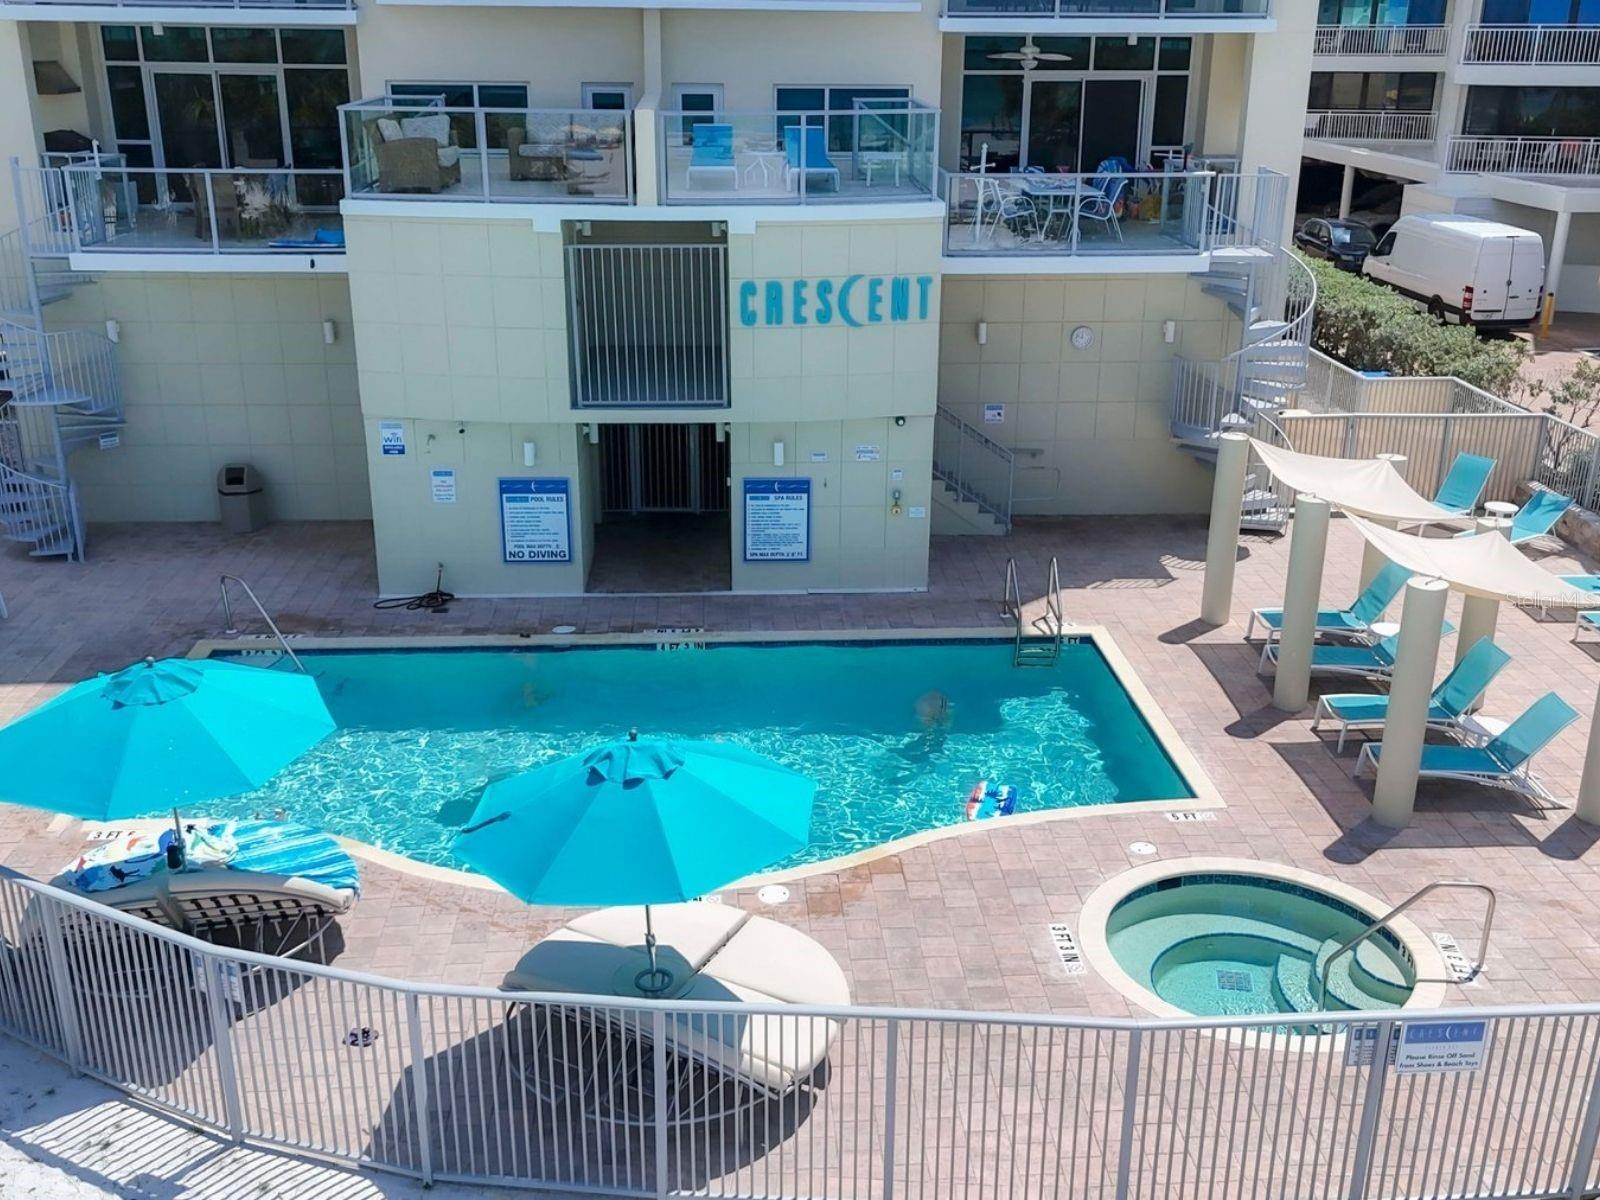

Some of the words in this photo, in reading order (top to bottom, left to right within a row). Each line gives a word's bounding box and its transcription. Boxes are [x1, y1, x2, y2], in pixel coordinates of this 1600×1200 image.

[740, 274, 933, 327] CRESCENT
[508, 550, 525, 559] NO
[528, 550, 567, 559] DIVING
[93, 831, 103, 839] 3
[106, 830, 123, 839] FT
[1054, 933, 1072, 943] FT
[1062, 953, 1081, 962] IN
